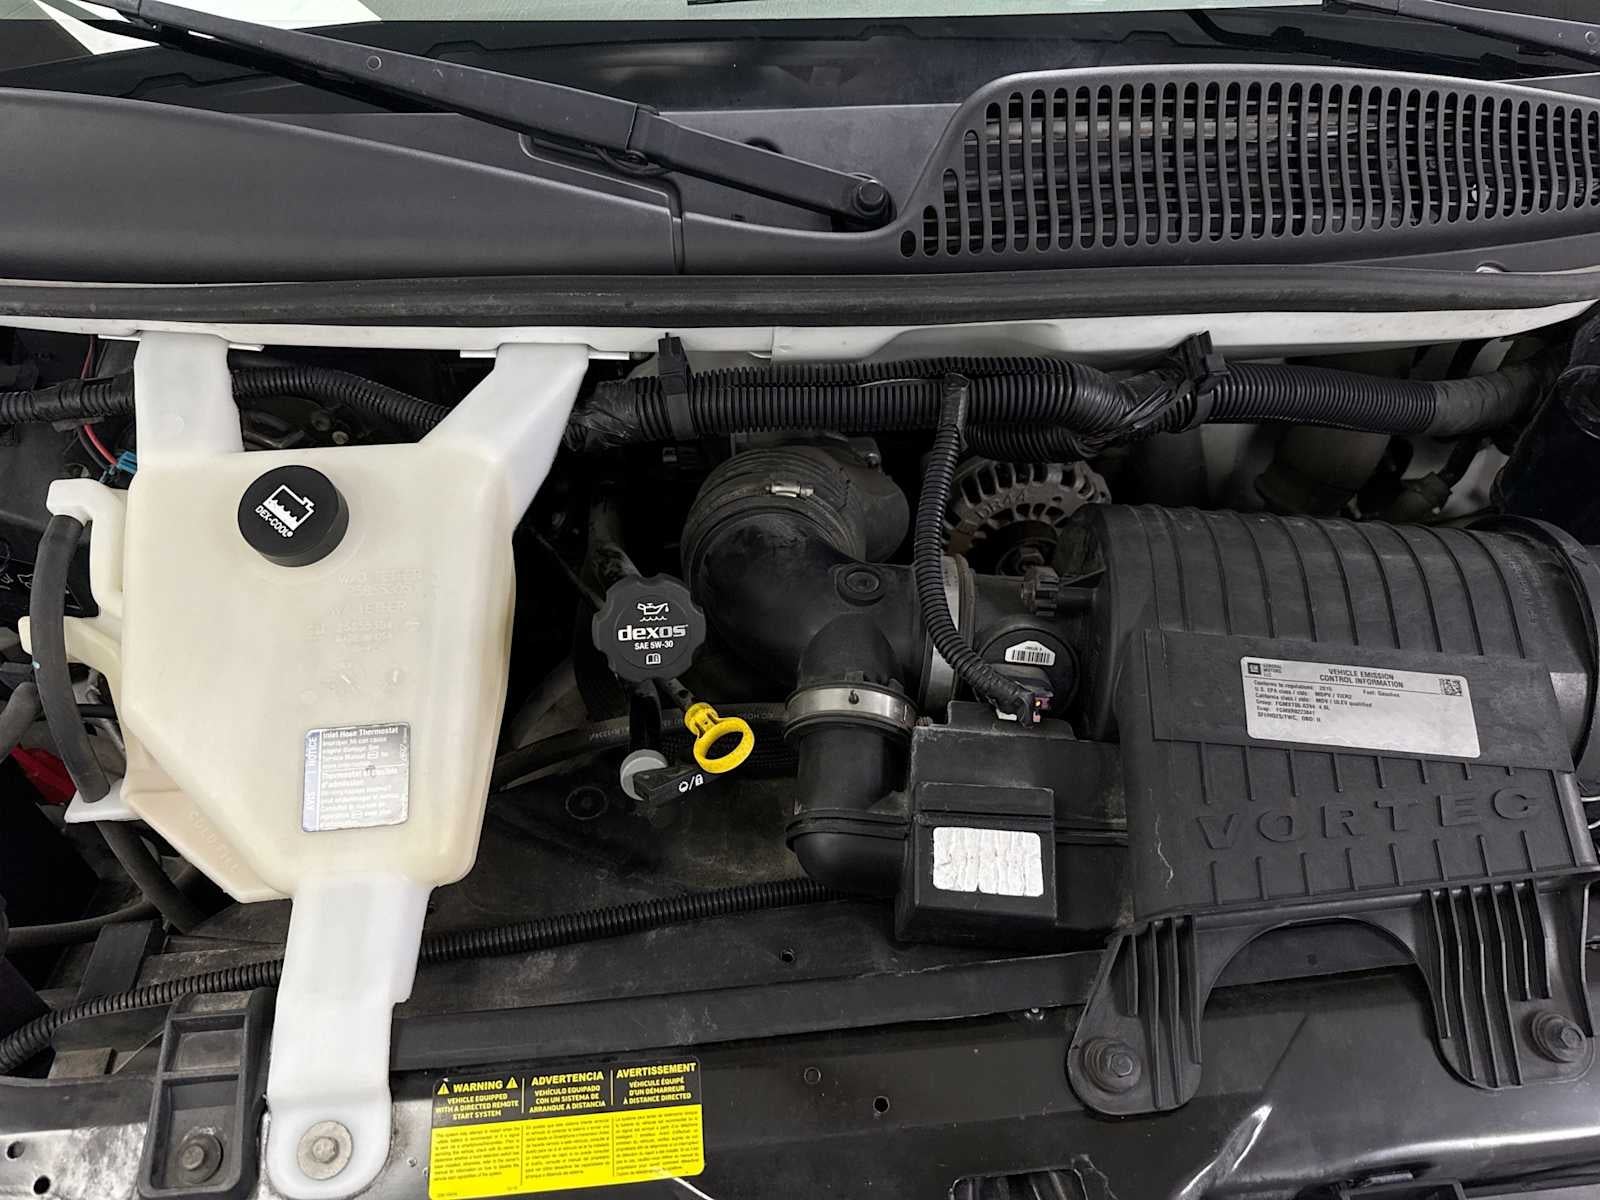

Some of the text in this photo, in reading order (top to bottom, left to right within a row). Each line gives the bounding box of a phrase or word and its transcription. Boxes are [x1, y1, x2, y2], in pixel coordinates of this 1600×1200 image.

[617, 624, 689, 641] dexos
[634, 640, 674, 650] SAE 5W-30
[1328, 668, 1394, 680] VEHICLE EMISSION
[1319, 674, 1404, 688] CONTROL INFORMATION
[322, 726, 399, 739] Inlet Hose Thermostat
[1195, 787, 1541, 850] VORTEC
[616, 1062, 696, 1079] AVERTISSEMENT
[531, 1071, 604, 1086] ADVERTENCIA
[453, 1080, 503, 1093] WARNING
[568, 1085, 600, 1094] EQUIPADO
[629, 1085, 685, 1096] D'UN DÉMARREUR
[447, 1093, 508, 1105] VEHICLE EQUIPPED
[536, 1092, 599, 1105] CON UN SISTEMA DE
[629, 1096, 660, 1105] DISTANCE
[660, 1092, 692, 1102] DIRECTED
[435, 1105, 453, 1113] WITH
[460, 1102, 491, 1111] DIRECTED
[492, 1100, 519, 1109] REMOTE
[529, 1104, 565, 1113] ARRANQUE
[571, 1100, 606, 1109] DISTANCIA
[453, 1109, 502, 1120] START SYSTEM
